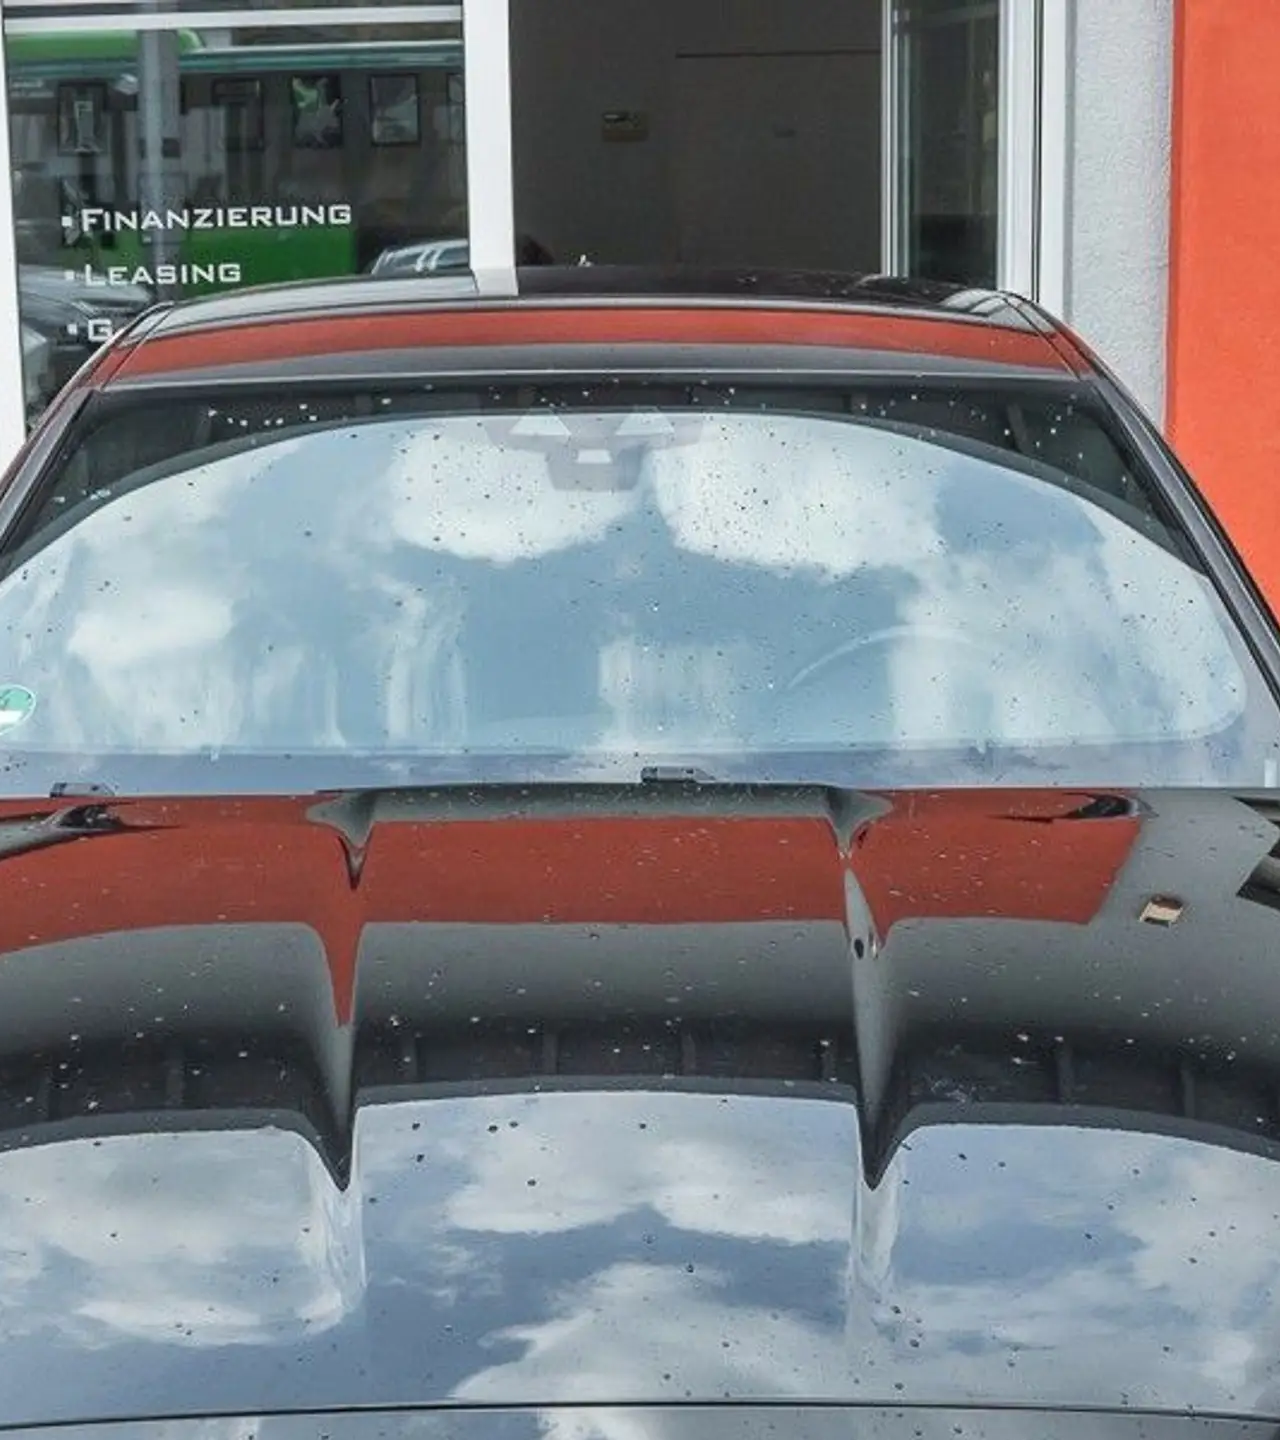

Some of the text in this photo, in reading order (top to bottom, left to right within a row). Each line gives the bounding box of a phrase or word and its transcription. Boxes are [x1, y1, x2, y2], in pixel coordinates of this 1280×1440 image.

[81, 204, 351, 231] FINANZIERUNG
[85, 263, 241, 286] LEASING
[87, 318, 113, 342] G
